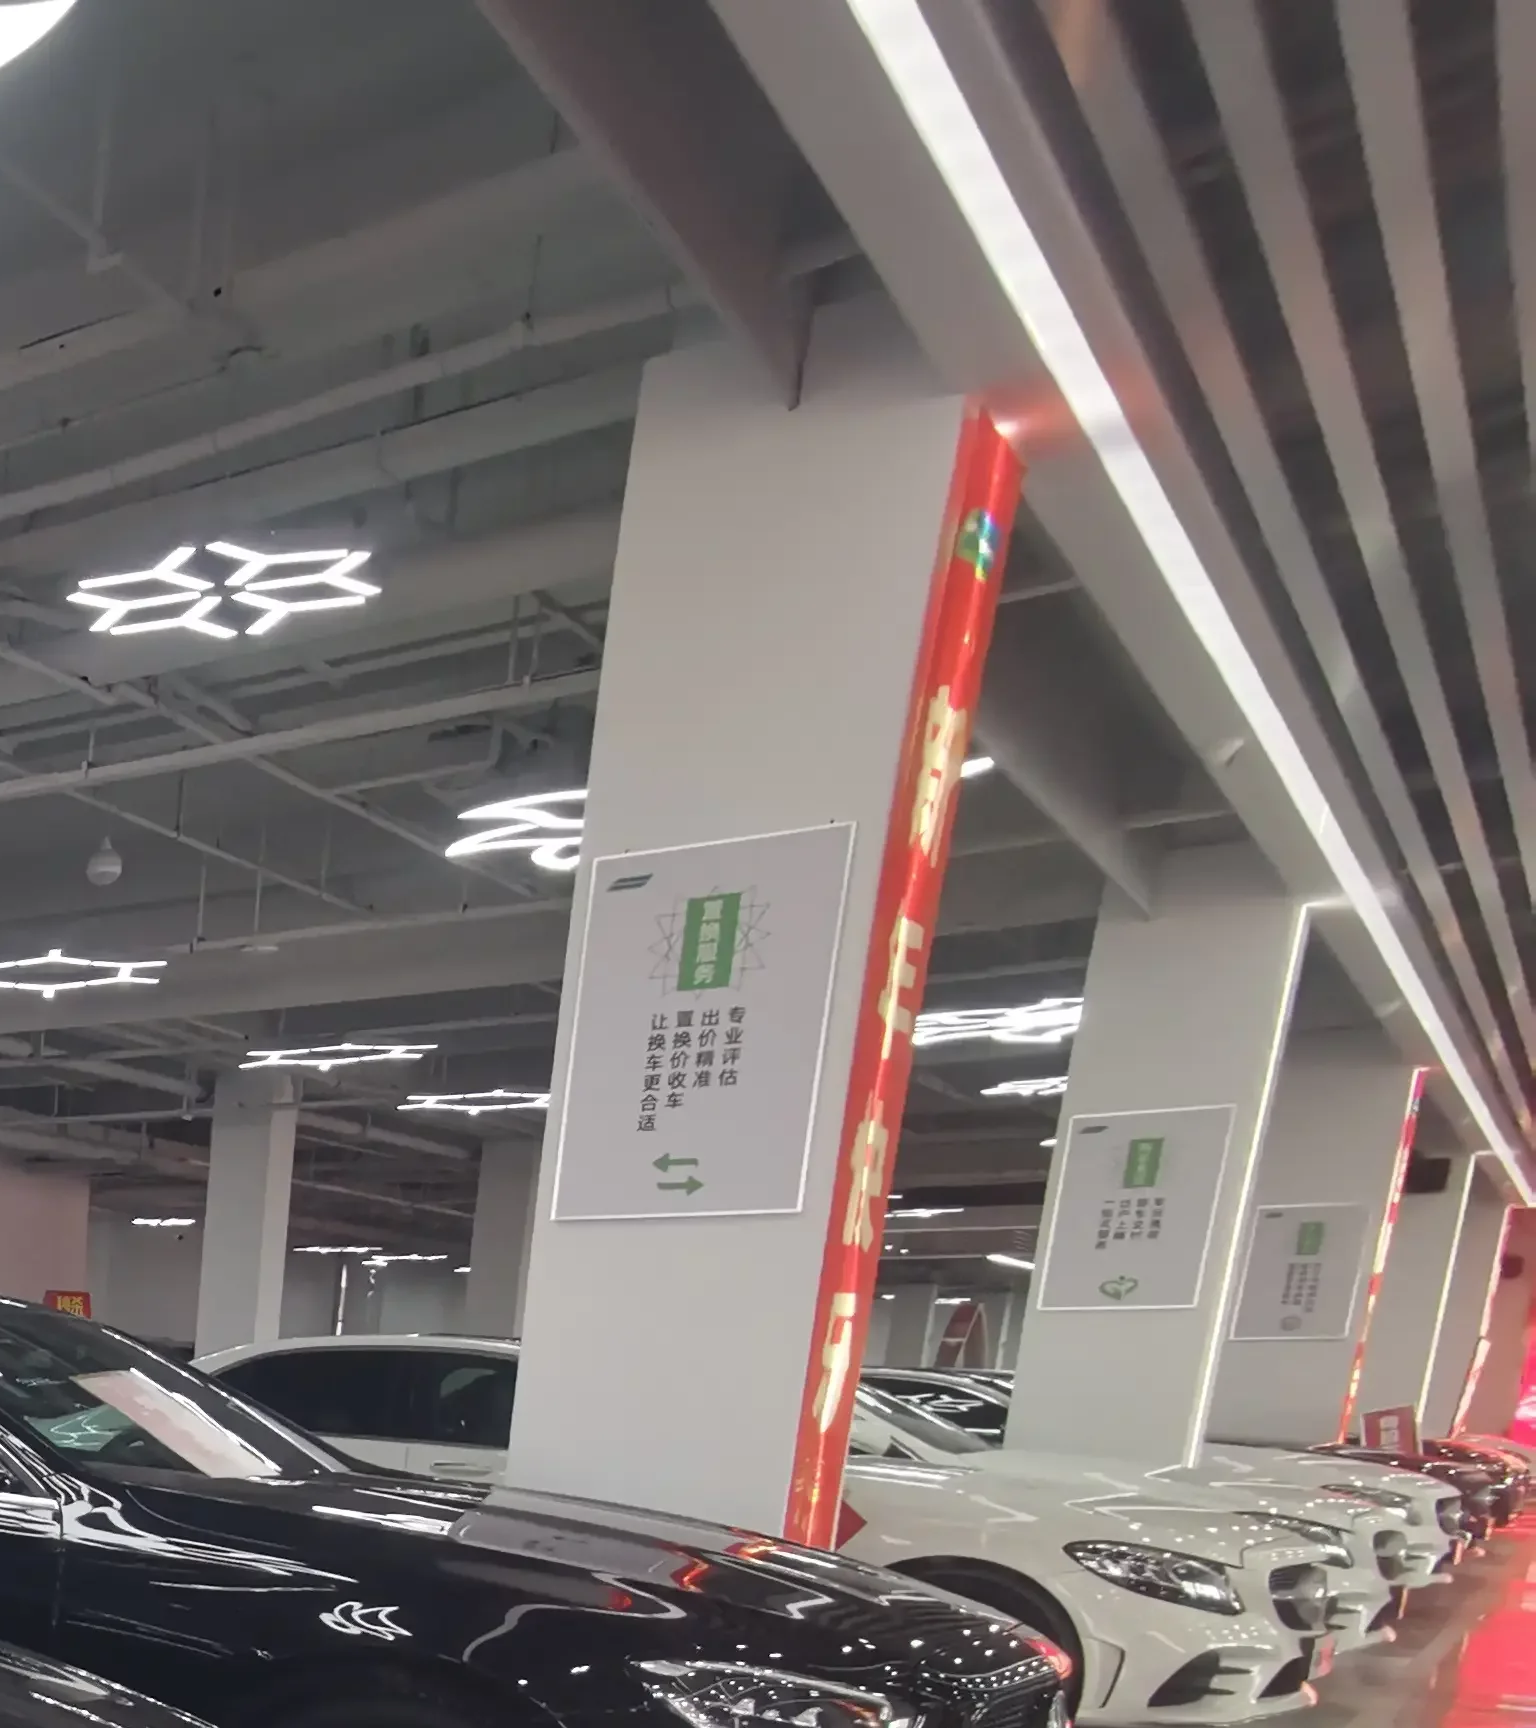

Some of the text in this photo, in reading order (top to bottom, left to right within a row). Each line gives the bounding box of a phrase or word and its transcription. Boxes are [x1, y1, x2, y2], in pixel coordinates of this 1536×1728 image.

[636, 1013, 668, 1133] 让换车更合适
[664, 1010, 695, 1109] 置换价收车
[692, 1009, 720, 1089] 出价精准
[718, 1005, 746, 1087] 专业评估
